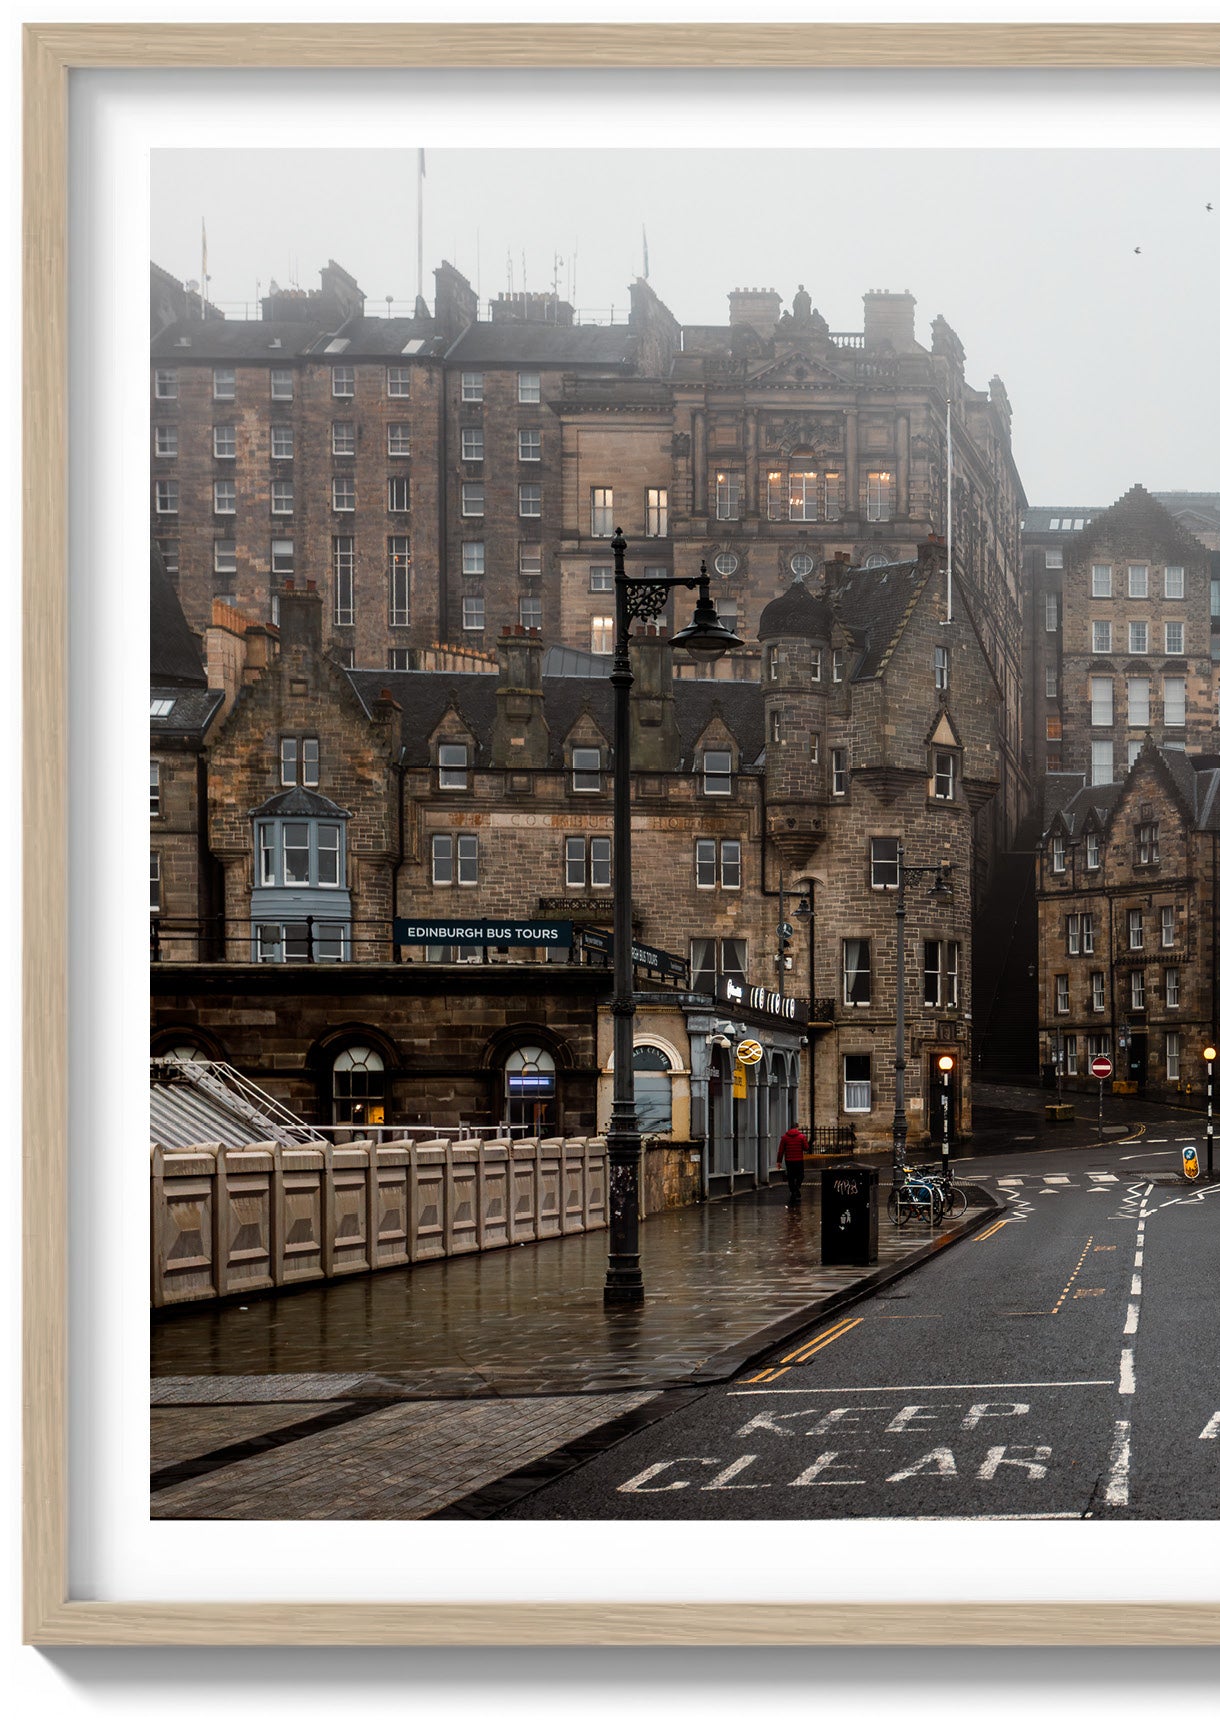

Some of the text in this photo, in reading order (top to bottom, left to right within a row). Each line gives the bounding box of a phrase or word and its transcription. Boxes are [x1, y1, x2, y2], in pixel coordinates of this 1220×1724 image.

[407, 927, 559, 939] EDINBURGH BUS TOURS
[646, 951, 658, 966] TOURS
[734, 1403, 1030, 1437] KEEP
[616, 1445, 1053, 1494] CLEAR
